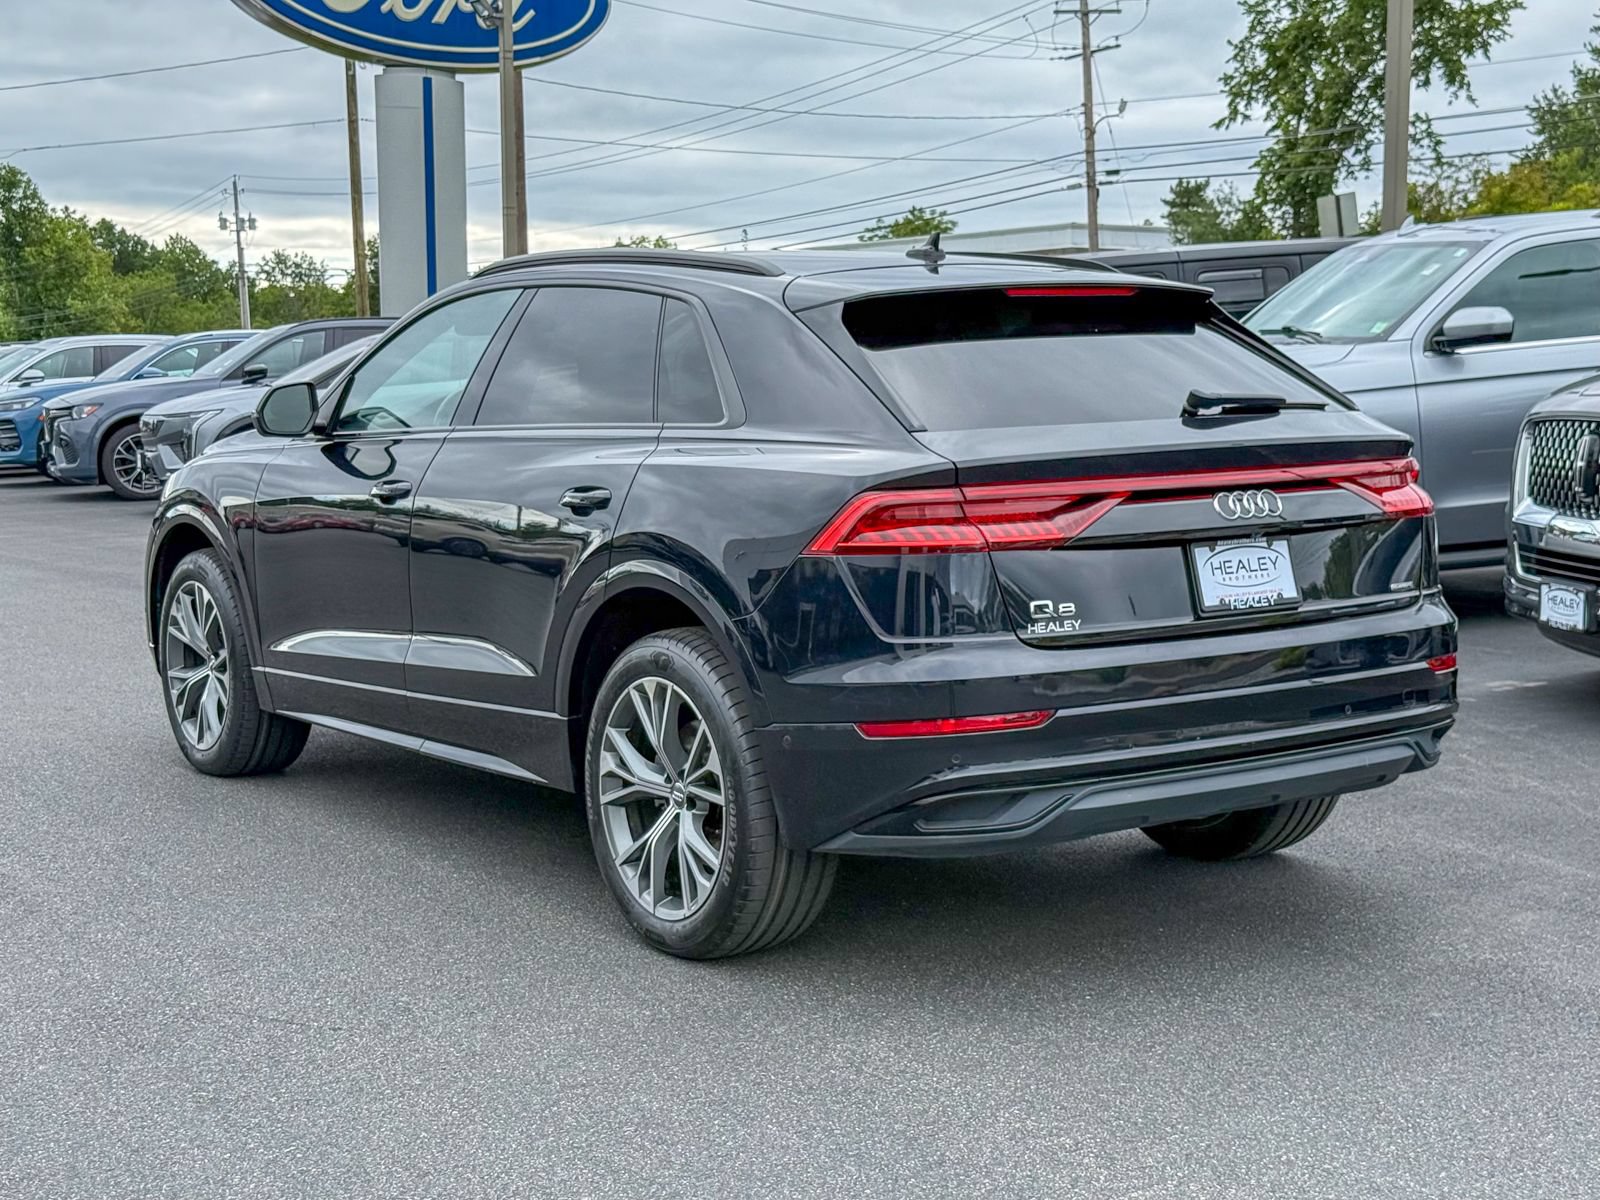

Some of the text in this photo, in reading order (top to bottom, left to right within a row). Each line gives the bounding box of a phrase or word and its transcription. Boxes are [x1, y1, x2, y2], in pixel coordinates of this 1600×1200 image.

[1210, 555, 1279, 576] HEALEY
[1222, 572, 1271, 582] BROTHERS
[1029, 600, 1076, 618] Q8
[1231, 595, 1275, 610] HEALEY
[1547, 594, 1580, 609] HEALEY
[1027, 619, 1082, 634] HEALEY
